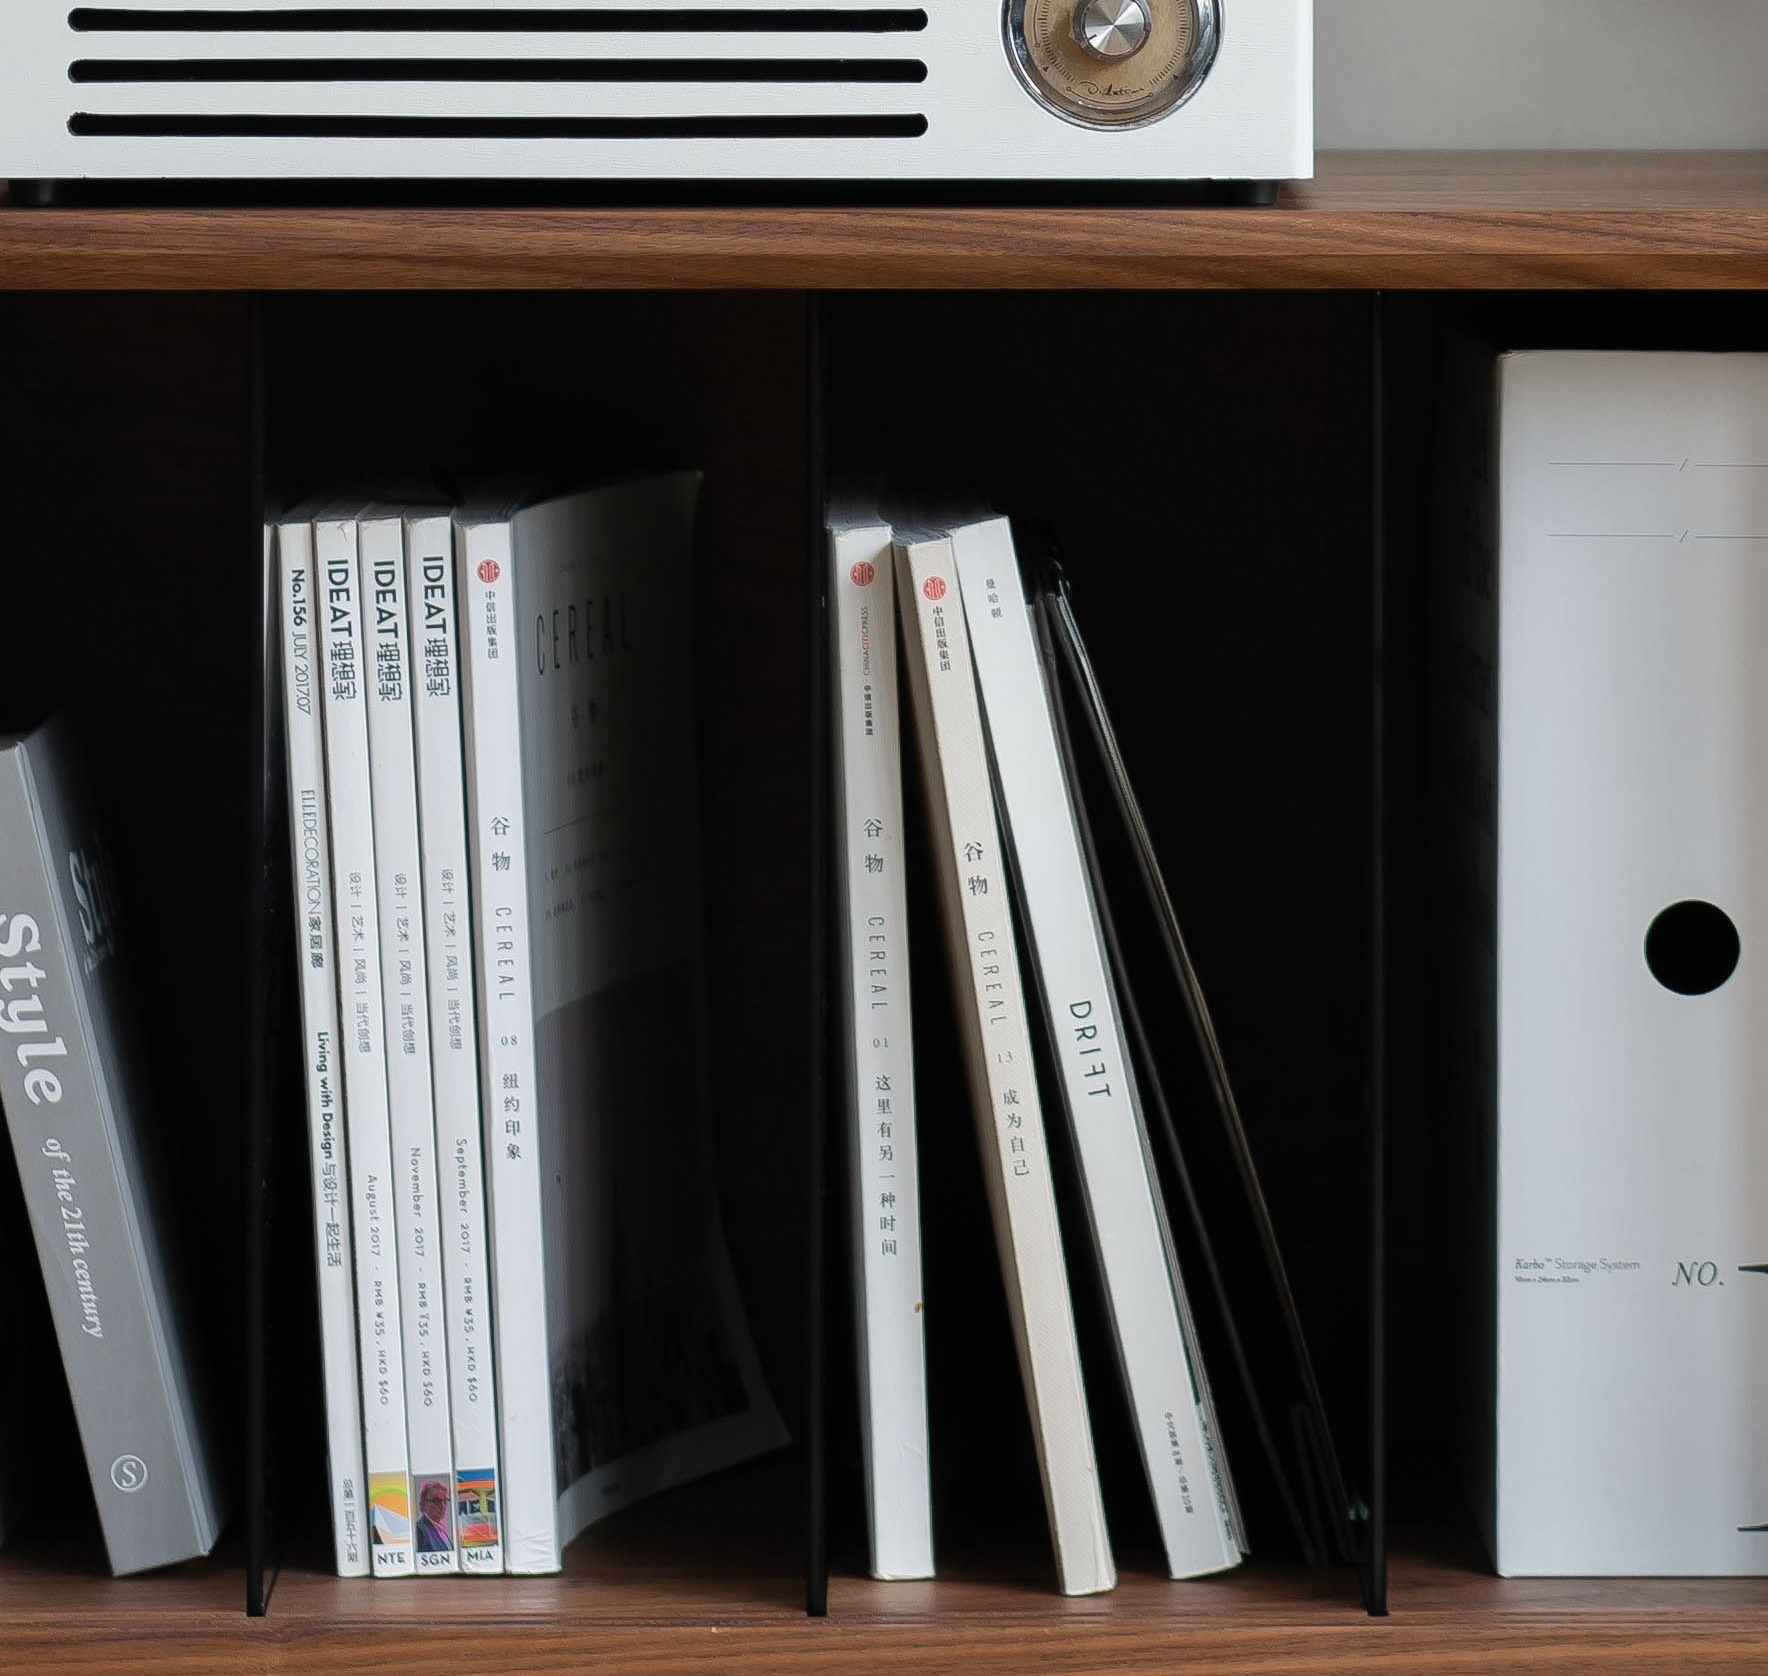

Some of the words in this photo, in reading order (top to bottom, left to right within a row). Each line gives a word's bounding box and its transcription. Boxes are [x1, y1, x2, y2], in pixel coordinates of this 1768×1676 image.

[292, 569, 307, 627] No.156
[327, 559, 353, 638] IDEAT
[373, 560, 399, 639] IDEAT
[423, 556, 448, 635] IDEAT
[985, 578, 1003, 619] 曼哈顿
[484, 590, 498, 660] 中信出版集团
[536, 589, 632, 675] CEREAL
[932, 605, 951, 672] 中信出版集团
[292, 633, 308, 661] JULY
[330, 640, 357, 701] 理想家
[376, 641, 403, 702] 理想家
[424, 637, 451, 697] 理想家
[490, 816, 511, 872] 谷物
[864, 818, 884, 874] 谷物
[440, 868, 456, 893] 设计
[964, 842, 988, 895] 谷物
[348, 871, 363, 898] 设计
[393, 872, 407, 898] 设计
[350, 915, 364, 941] 艺术
[395, 916, 410, 943] 艺术
[443, 913, 456, 938] 艺术
[445, 955, 458, 981] 风尚
[495, 906, 516, 1001] CEREAL
[868, 916, 889, 1010] CEREAL
[353, 958, 367, 985] 风尚
[398, 959, 412, 986] 风尚
[977, 931, 1007, 1026] CEREAL
[315, 1031, 329, 1073] Living
[500, 1034, 518, 1046] 08
[873, 1037, 888, 1048] 01
[1070, 1000, 1112, 1098] DRIFT
[997, 1051, 1013, 1064] 13
[319, 1077, 333, 1108] with
[502, 1073, 521, 1160] 纽约印象
[320, 1113, 336, 1159] Design
[1003, 1089, 1029, 1177] 成为自己
[43, 1138, 71, 1163] of
[875, 1075, 897, 1257] 这里有另一种时间
[52, 1168, 76, 1203] the
[410, 1147, 423, 1218] November
[455, 1138, 470, 1215] September
[366, 1174, 379, 1222] August
[61, 1206, 90, 1255] 21th
[322, 1164, 342, 1268] 与设计一起生活
[370, 1227, 380, 1257] 2017
[414, 1226, 424, 1257] 2017
[460, 1223, 471, 1254] 2017
[1554, 1258, 1597, 1273] Storage
[1599, 1258, 1640, 1273] System
[1672, 1261, 1724, 1286] NO.
[73, 1258, 105, 1339] century
[374, 1280, 383, 1307] RMB
[417, 1282, 427, 1308] RMB
[463, 1277, 473, 1304] RMB
[377, 1349, 388, 1375] HKD
[421, 1350, 431, 1376] HKD
[466, 1347, 476, 1372] HKD
[378, 1380, 389, 1406] $60
[422, 1381, 433, 1407] $60
[467, 1377, 478, 1402] $60
[377, 1551, 405, 1565] NTE
[420, 1553, 450, 1567] SGN
[466, 1550, 494, 1563] MIA
